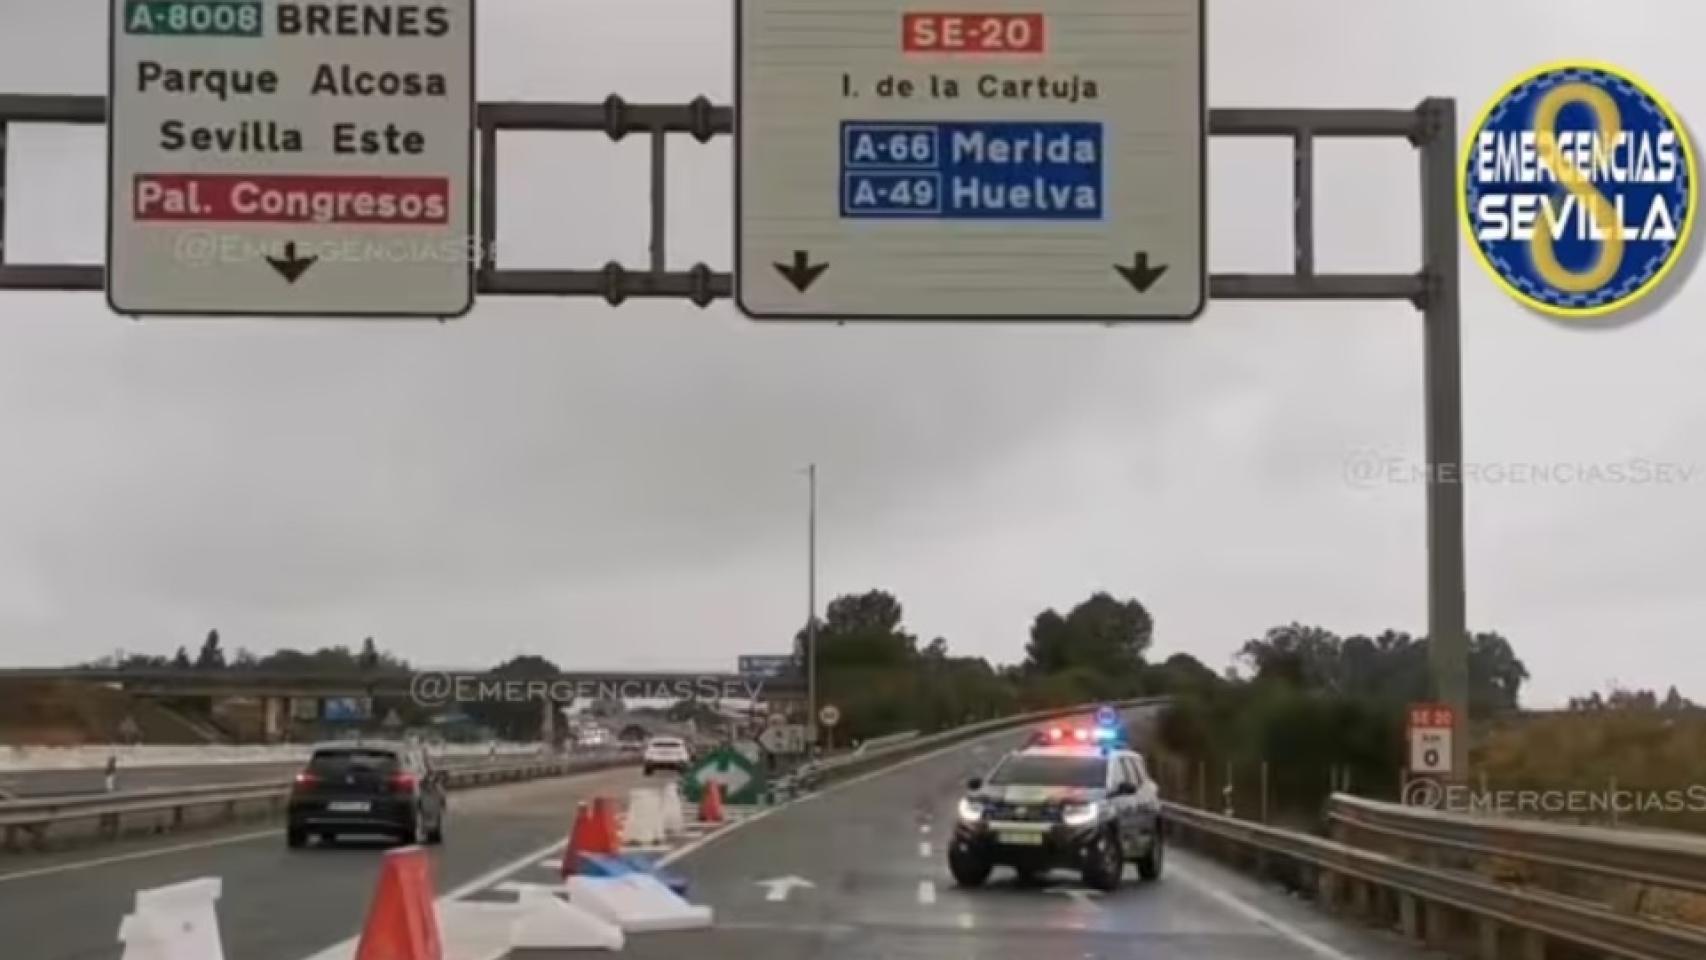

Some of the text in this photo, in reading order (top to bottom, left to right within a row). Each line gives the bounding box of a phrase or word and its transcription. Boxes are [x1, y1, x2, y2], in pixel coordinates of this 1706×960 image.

[129, 3, 260, 31] A-8008
[277, 6, 450, 36] BRENES
[913, 18, 1031, 48] SE-20
[137, 61, 447, 100] Parque Alcosa
[876, 75, 914, 98] de
[931, 75, 959, 98] la
[977, 74, 1099, 102] Cartuja
[160, 121, 426, 154] Sevilla Este
[853, 134, 931, 161] A-66
[138, 182, 445, 221] Pal. Congresos
[854, 177, 1096, 209] A-49 Huelva
[1424, 750, 1439, 767] 0
